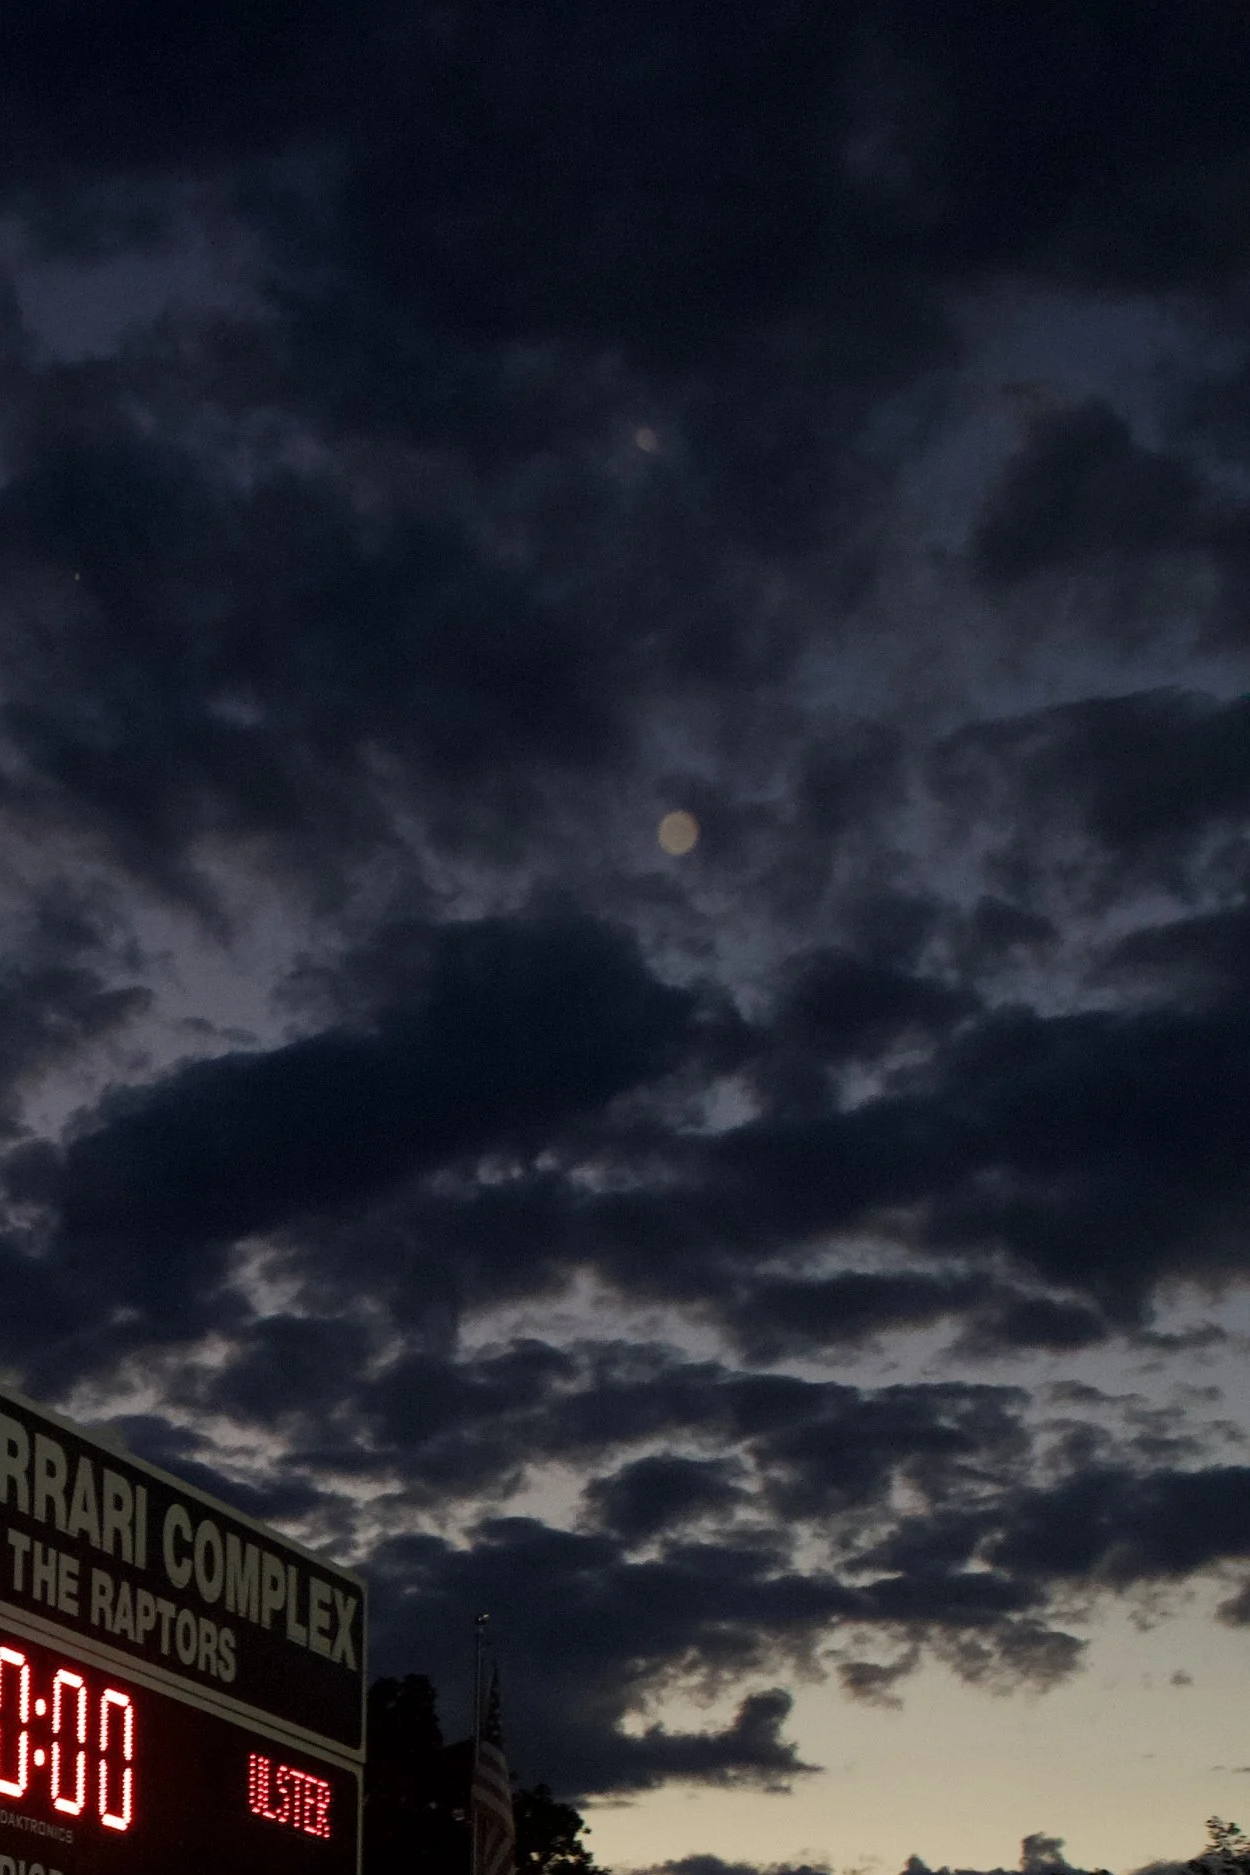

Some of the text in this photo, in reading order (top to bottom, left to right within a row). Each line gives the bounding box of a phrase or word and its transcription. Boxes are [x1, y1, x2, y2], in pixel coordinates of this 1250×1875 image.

[8, 1527, 80, 1618] THE
[91, 1568, 238, 1683] RAPTORS
[162, 1503, 358, 1671] COMPLEX
[0, 1808, 74, 1844] DAKTRONICS
[249, 1753, 331, 1838] ULSTER
